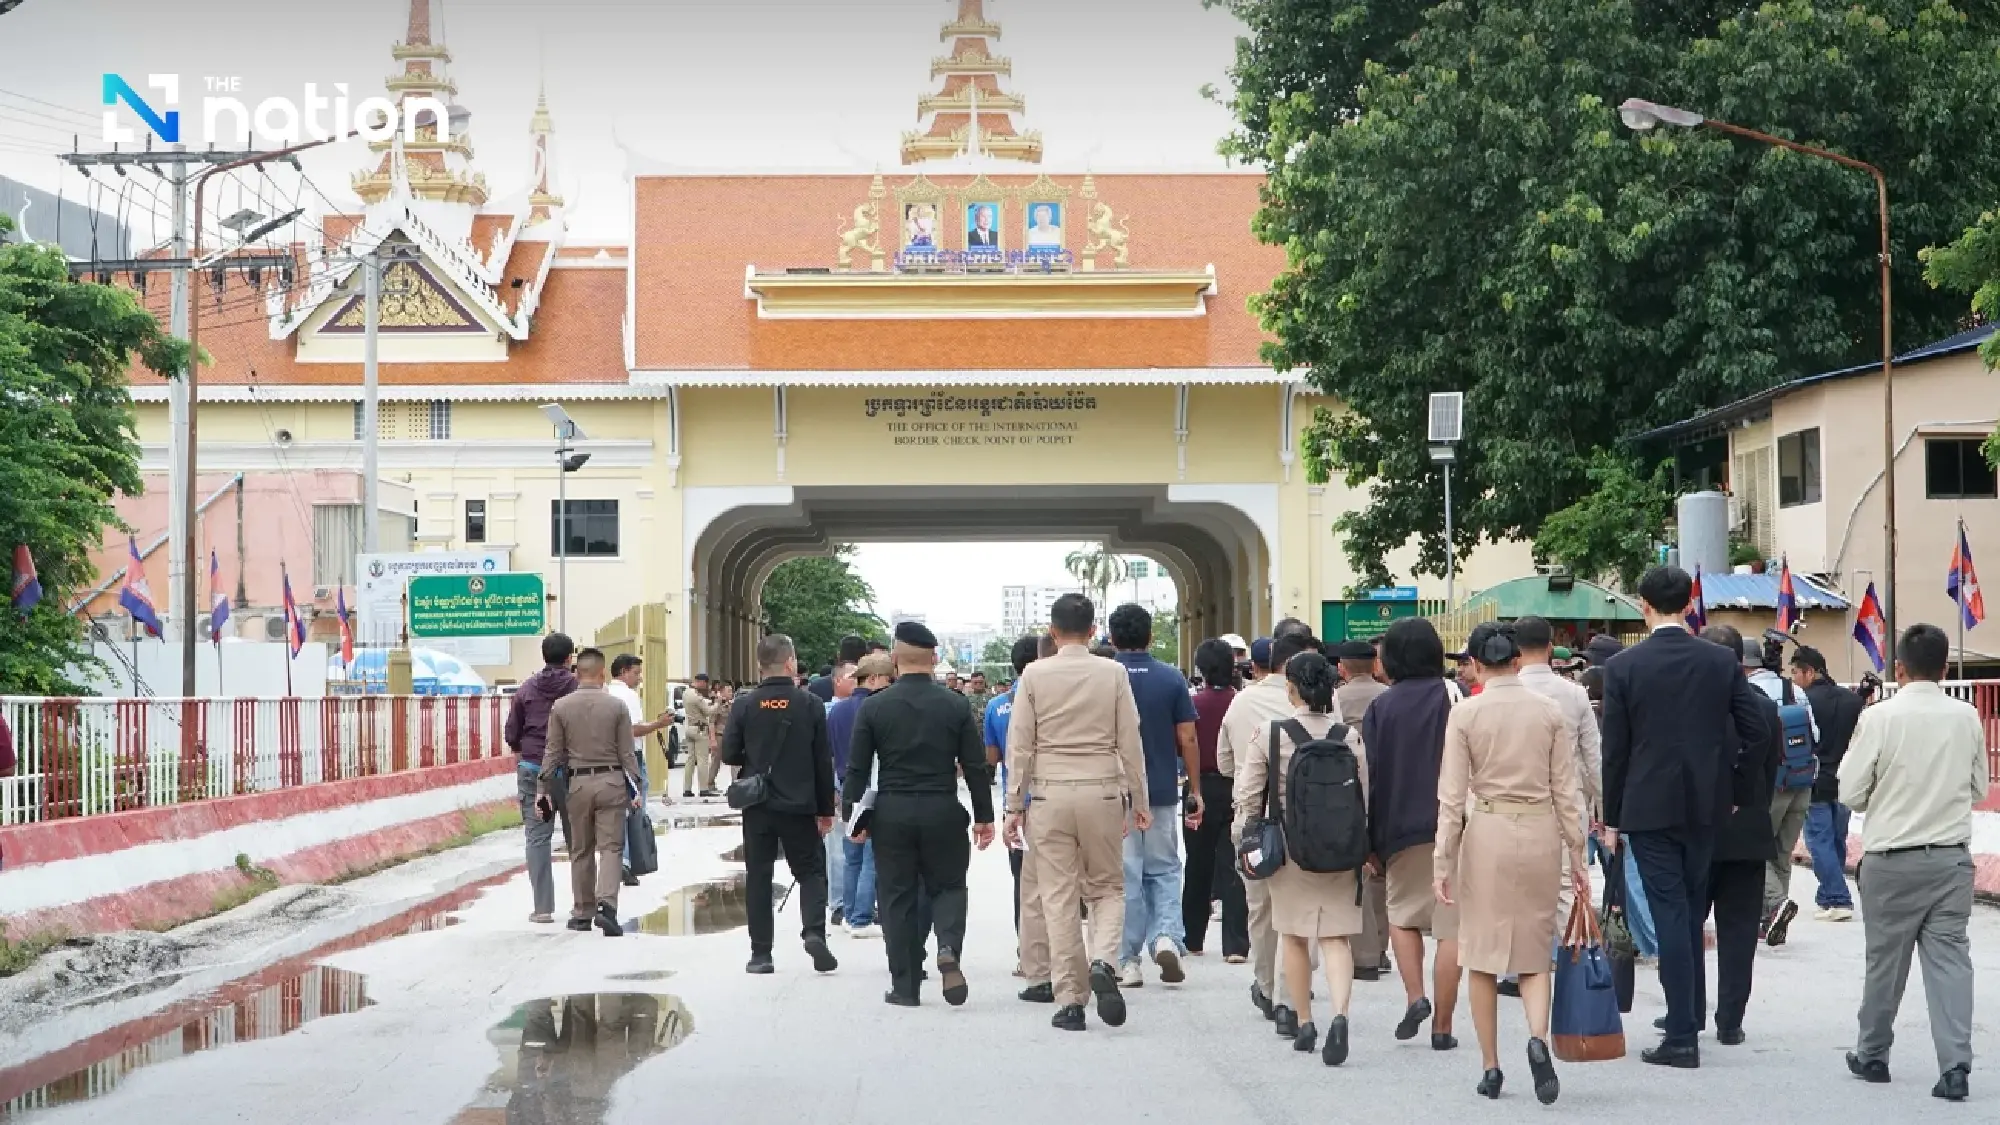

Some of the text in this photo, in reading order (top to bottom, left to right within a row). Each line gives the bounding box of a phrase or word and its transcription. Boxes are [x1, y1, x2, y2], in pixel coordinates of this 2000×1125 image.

[887, 422, 1079, 432] THE OFFICE OF THE INTERNATIONAL
[894, 435, 1073, 446] BORDER CHECK POINT OF POIPET
